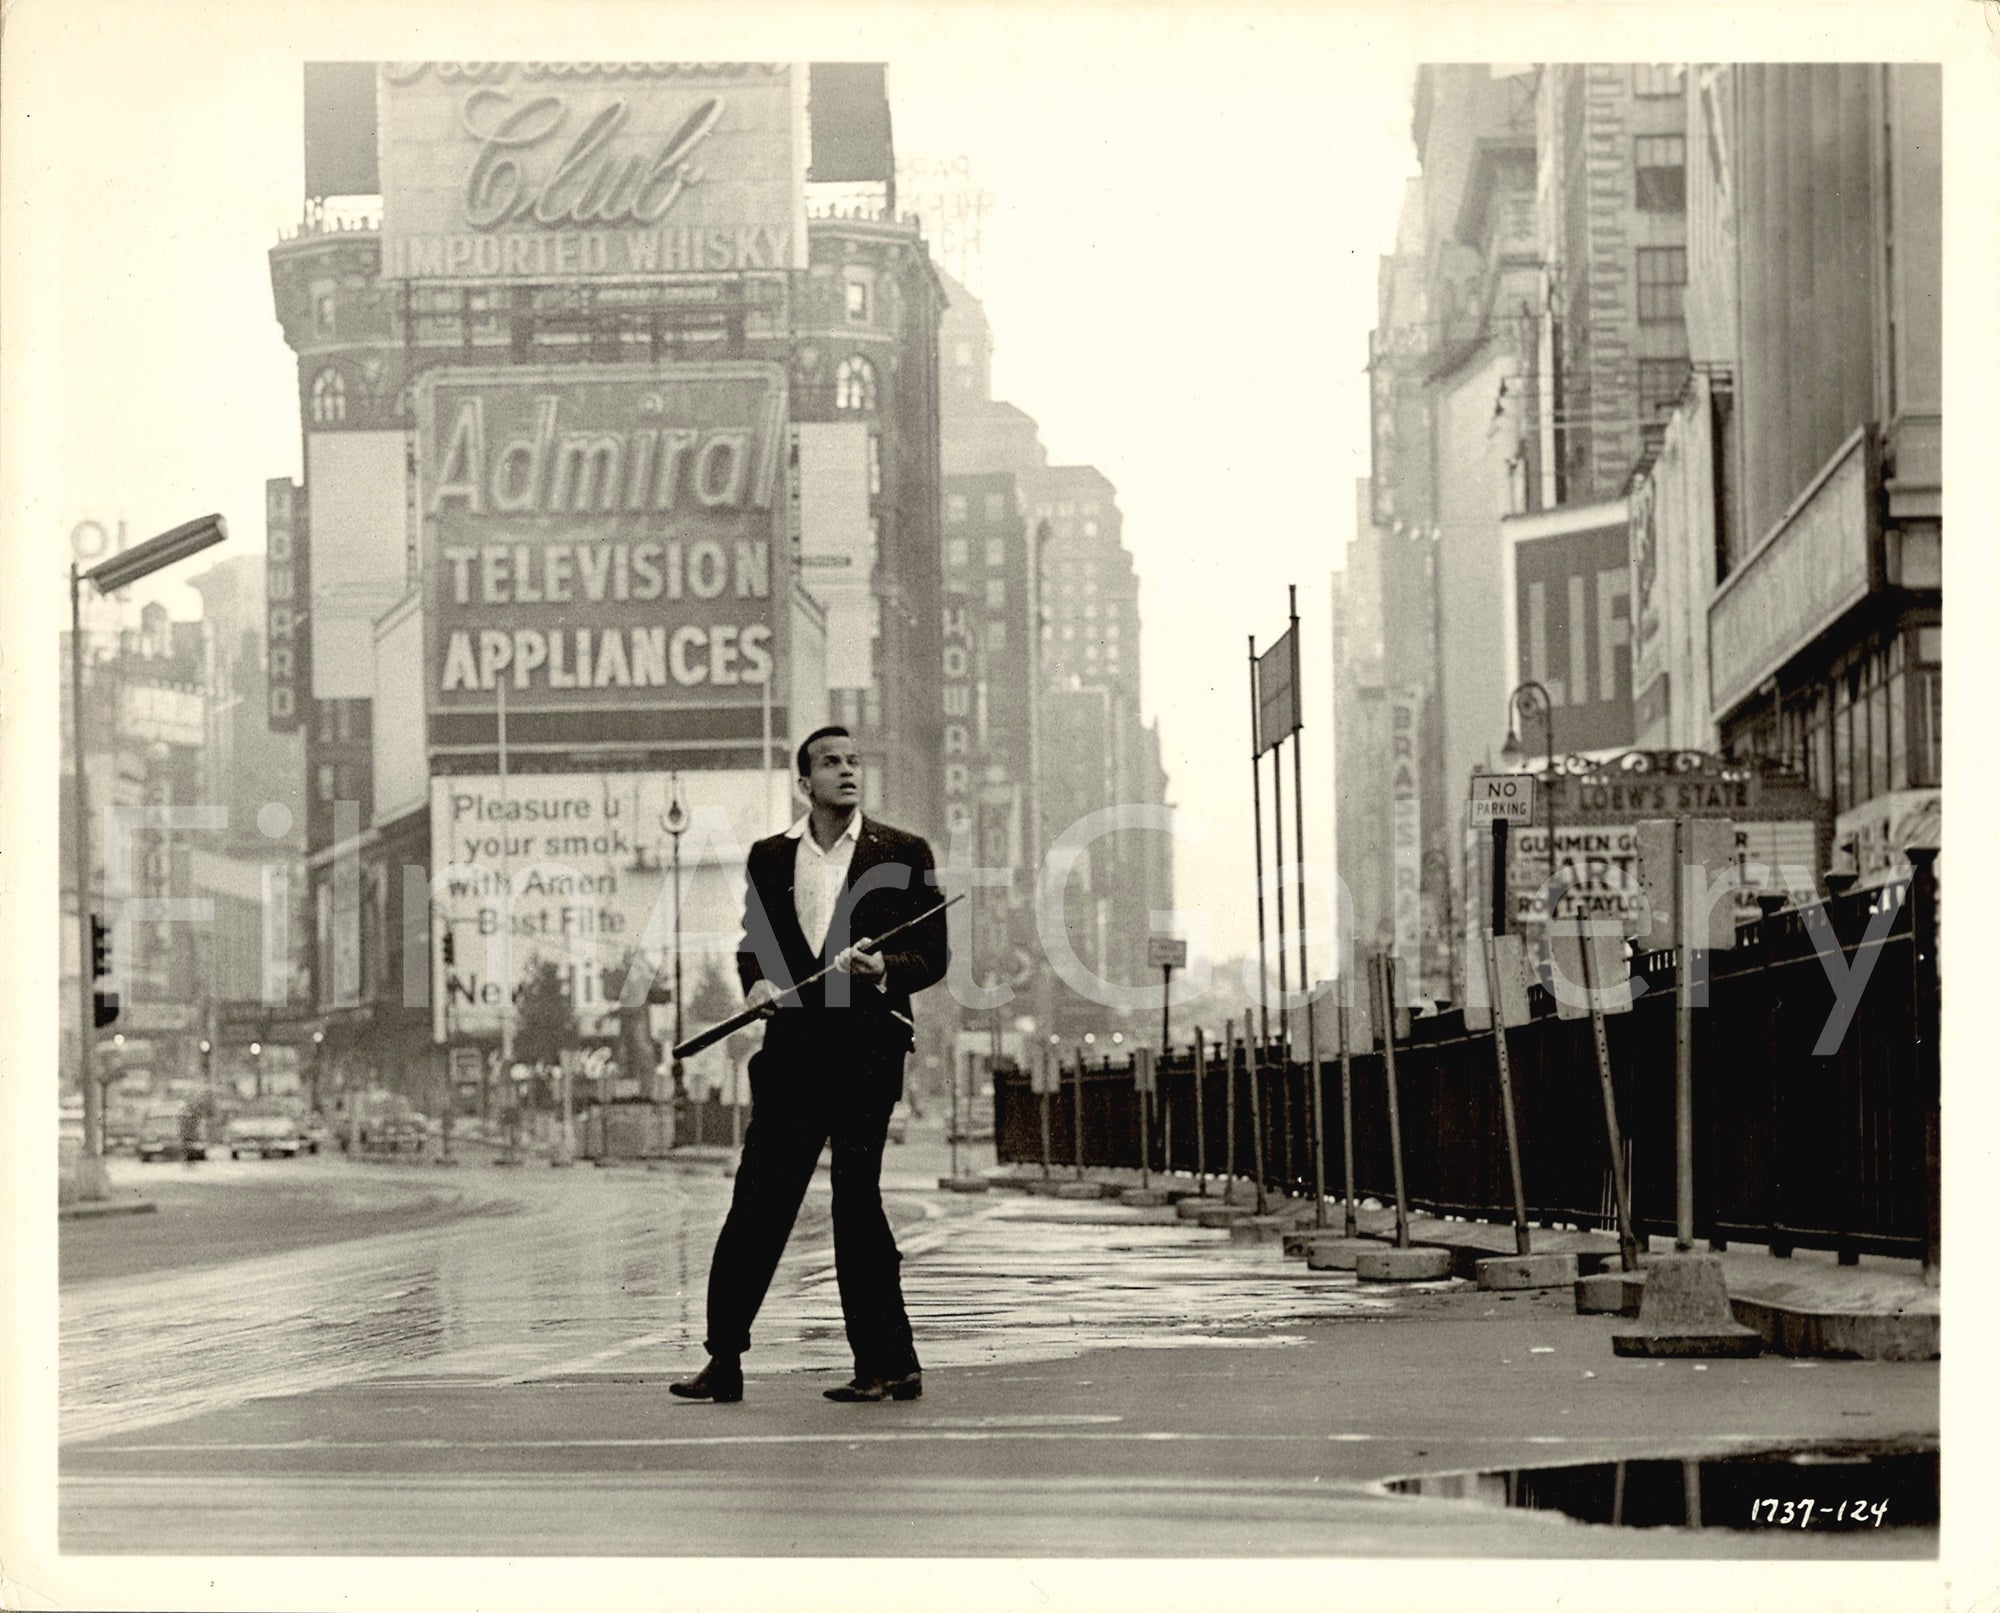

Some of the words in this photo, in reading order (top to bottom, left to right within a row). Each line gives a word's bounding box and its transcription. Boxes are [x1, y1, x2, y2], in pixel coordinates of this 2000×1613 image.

[462, 90, 726, 230] Club
[397, 229, 609, 278] IMPORTED
[627, 217, 791, 263] WHISKY
[430, 391, 787, 512] Admiral
[444, 541, 771, 602] TELEVISION
[269, 491, 296, 718] HOWARD
[442, 624, 773, 692] APPLIANCES
[454, 795, 591, 820] Pleasure
[1477, 802, 1527, 816] PARKING
[1488, 782, 1517, 798] NO
[1677, 781, 1748, 808] STATE
[465, 836, 535, 864] your
[1520, 835, 1609, 851] GUNMEN
